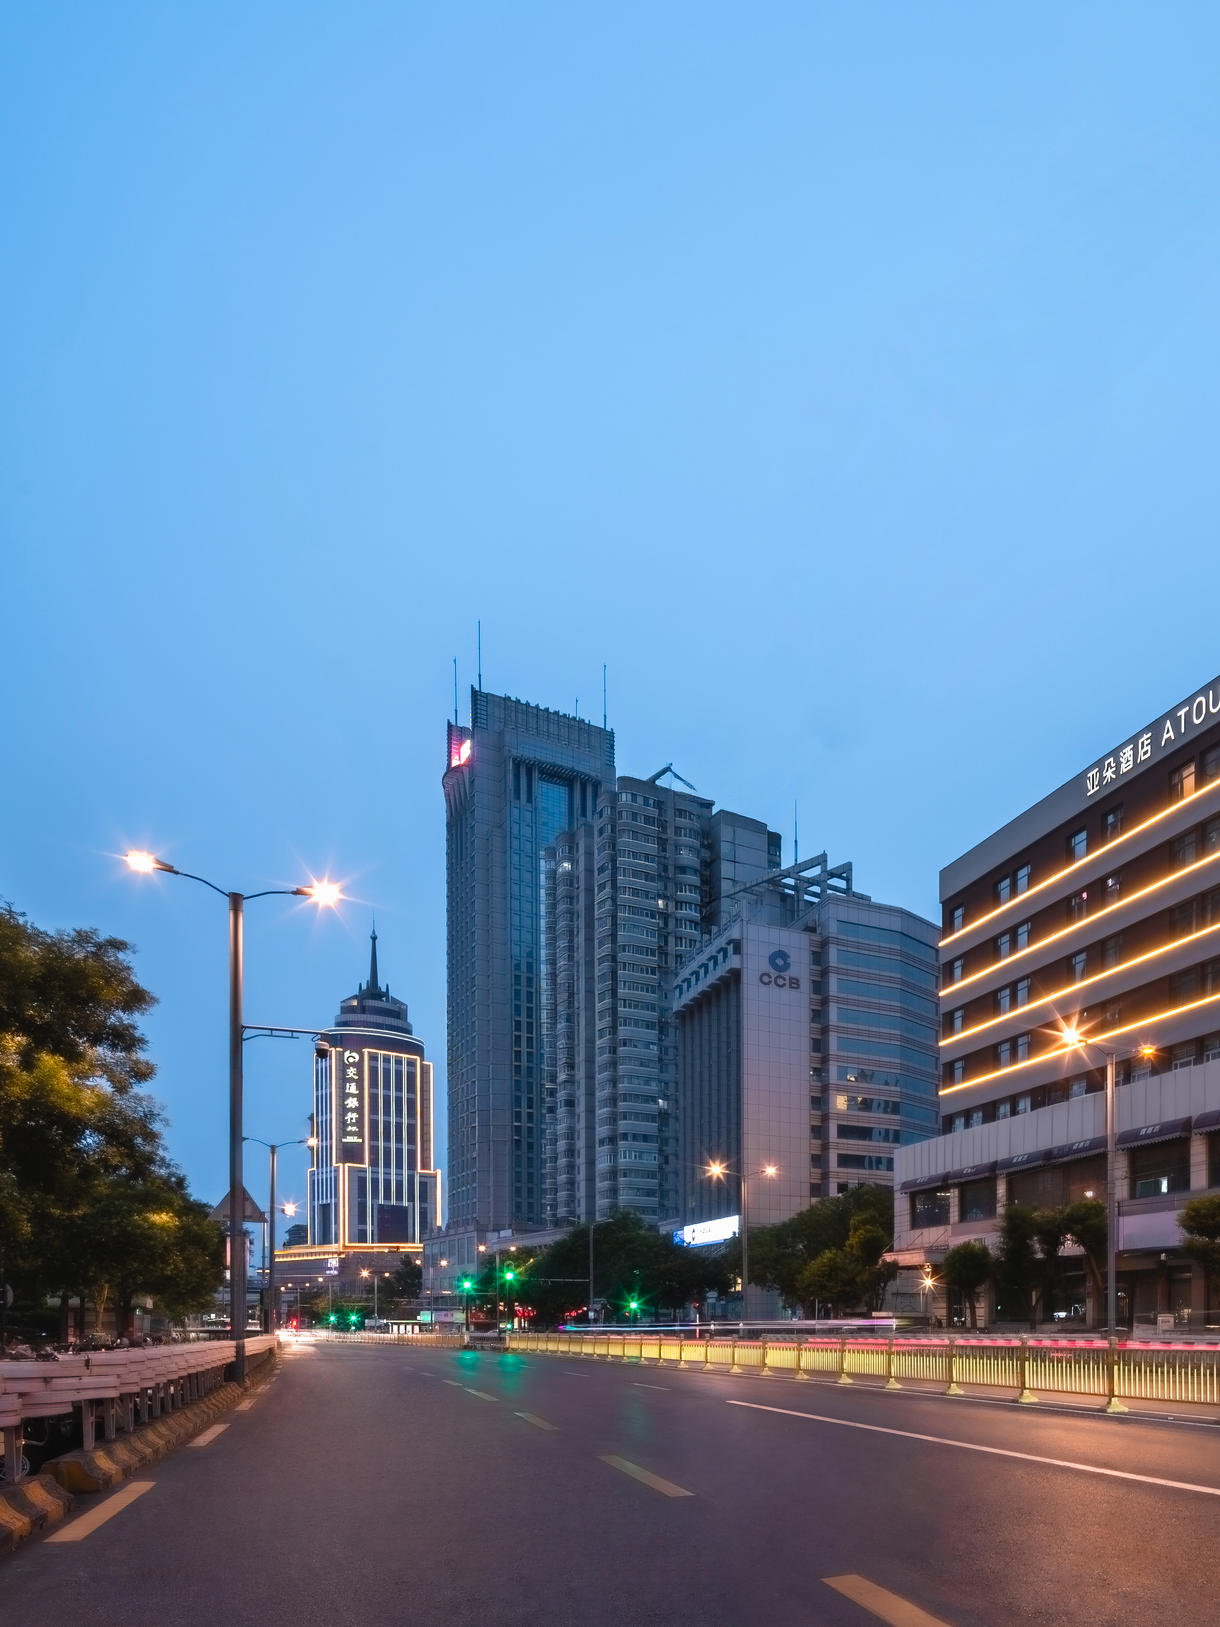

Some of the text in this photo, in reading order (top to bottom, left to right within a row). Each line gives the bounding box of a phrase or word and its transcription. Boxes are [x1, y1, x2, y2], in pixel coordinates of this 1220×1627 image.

[1086, 732, 1152, 797] 亚朵酒店
[760, 972, 801, 990] CCB
